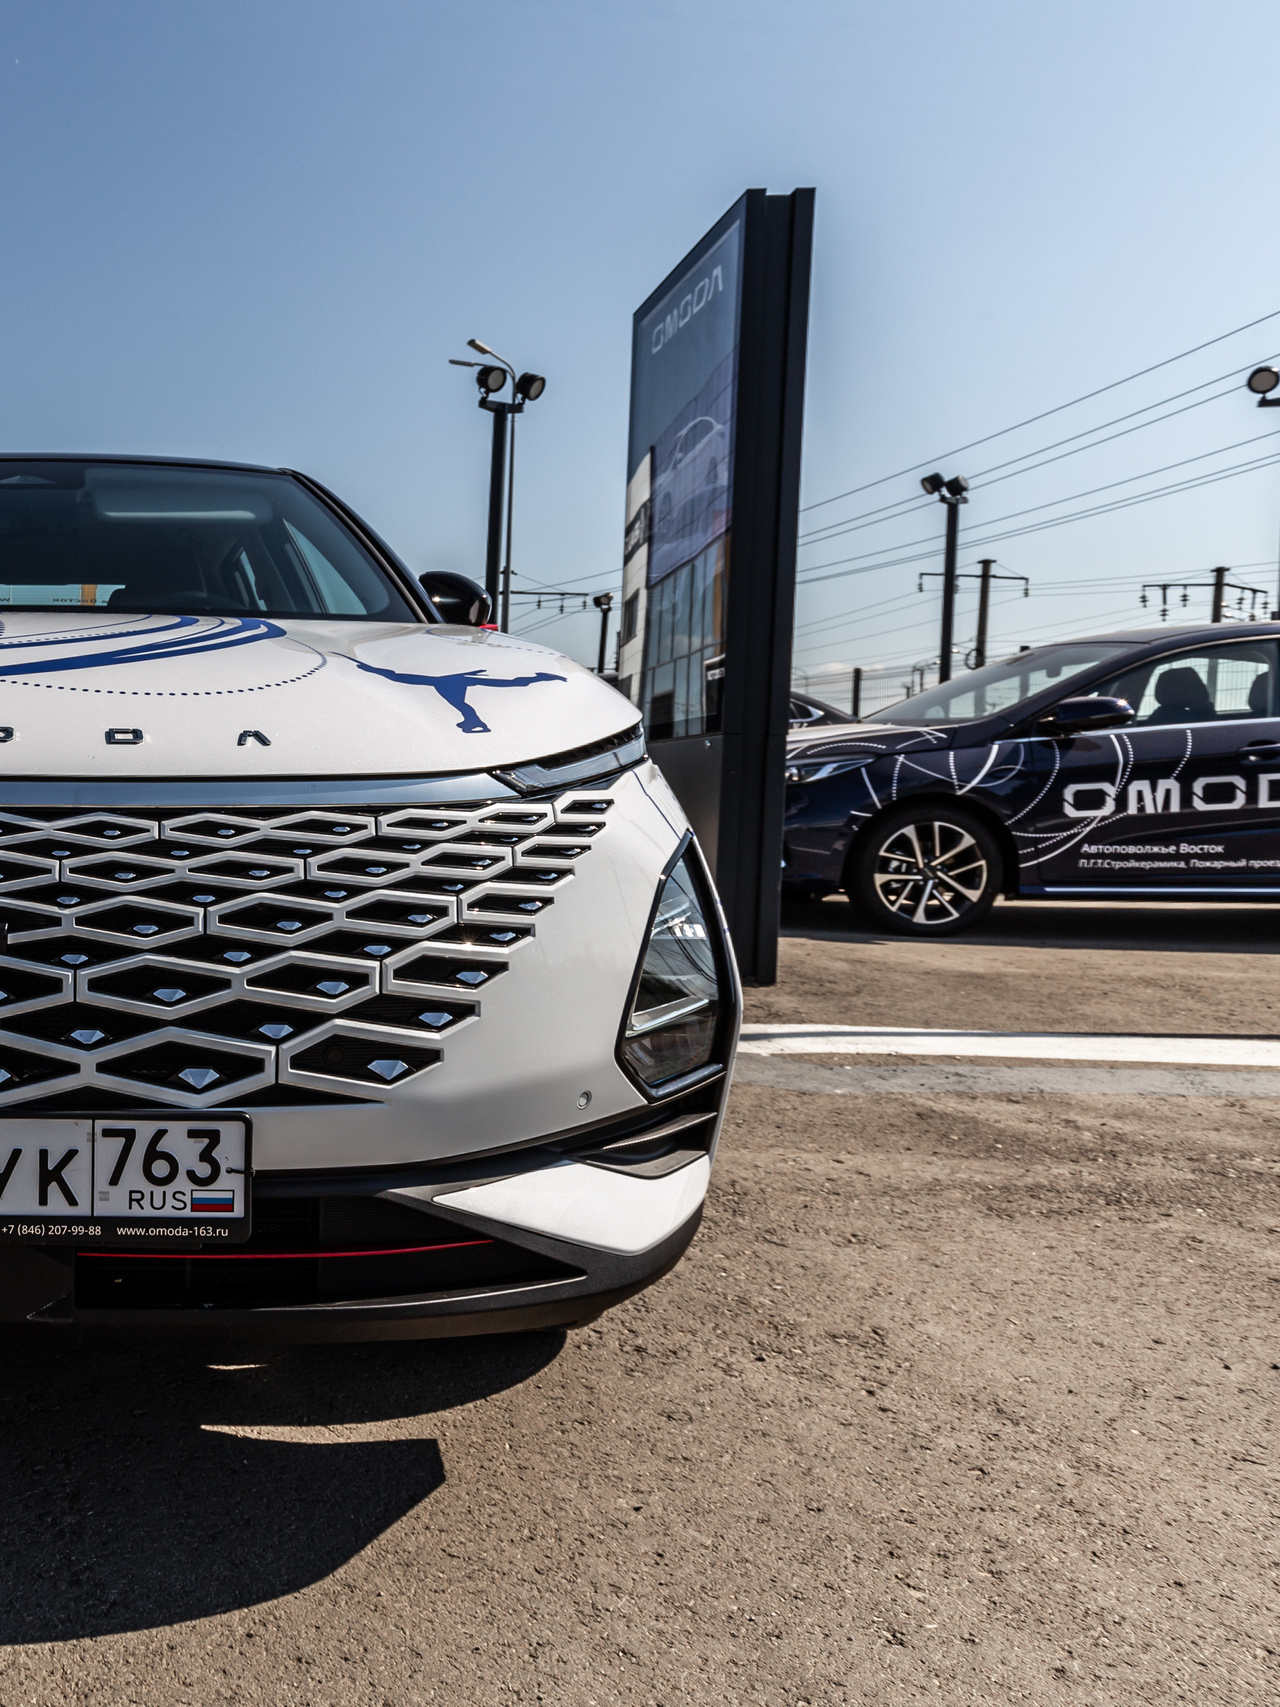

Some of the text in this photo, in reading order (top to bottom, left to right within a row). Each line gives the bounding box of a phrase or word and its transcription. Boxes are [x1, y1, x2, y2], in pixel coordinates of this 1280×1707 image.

[1081, 843, 1224, 854] Автоповолжье Восток
[1190, 858, 1247, 869] Пожарный
[102, 1128, 221, 1187] 763
[128, 1189, 187, 1211] RUS
[1, 1224, 15, 1236] +7
[17, 1224, 45, 1236] (846)
[48, 1225, 102, 1236] 207-99-88
[116, 1225, 229, 1237] www.omoda-163.ru
